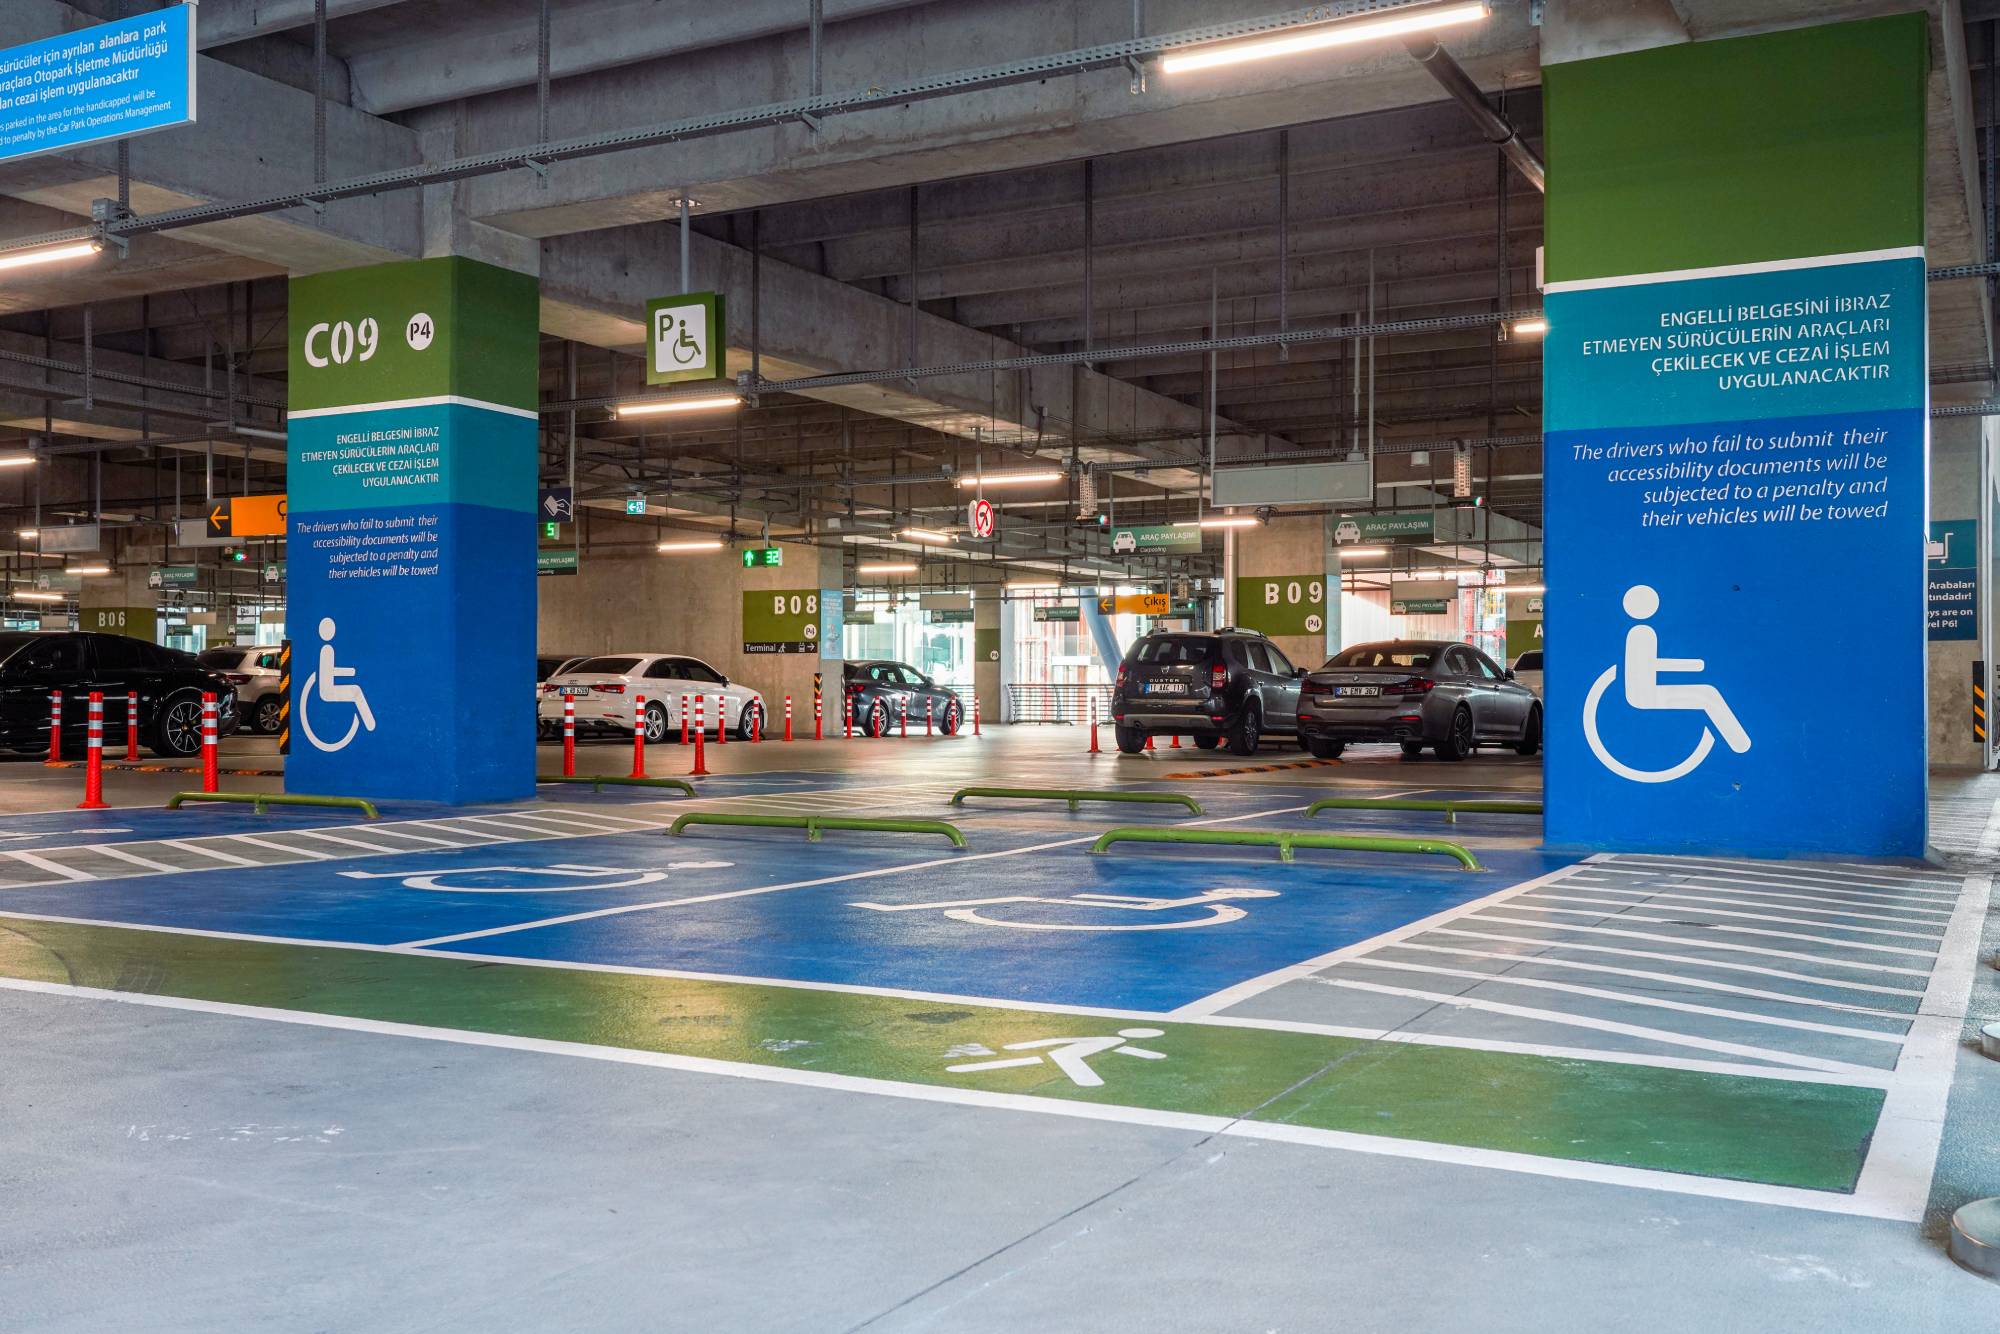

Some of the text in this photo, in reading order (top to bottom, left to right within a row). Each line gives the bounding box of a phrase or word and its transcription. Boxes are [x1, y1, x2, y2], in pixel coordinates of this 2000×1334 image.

[0, 21, 166, 74] sürücüler için ayrılan alanlara park
[34, 63, 72, 83] Otopark
[75, 57, 110, 76] İşletme
[112, 40, 167, 64] Müdürlüğü
[15, 90, 38, 106] cezai
[40, 86, 65, 103] işlem
[67, 68, 139, 96] uygulanacaktır
[6, 117, 27, 132] parked
[28, 116, 35, 125] in
[36, 114, 46, 123] the
[48, 112, 62, 121] area
[63, 107, 72, 118] for
[74, 105, 85, 115] the
[86, 93, 130, 112] handicapped
[133, 90, 144, 102] will
[146, 88, 156, 99] be
[4, 136, 11, 144] to
[12, 130, 36, 144] penalty
[38, 128, 45, 139] by
[47, 125, 57, 135] the
[59, 123, 69, 133] Car
[71, 119, 85, 130] Park
[86, 112, 124, 128] Operations
[125, 100, 171, 118] Management
[1661, 294, 1891, 328] ENGELLİ BELGESİNİ İBRAZ
[410, 321, 431, 341] P4
[660, 314, 674, 342] P
[1583, 318, 1890, 355] ETMEYEN SÜRÜCÜLERİN ARAÇLARI
[305, 318, 379, 368] C09
[1652, 341, 1890, 376] ÇEKİLECEK VE CEZAİ İŞLEM
[1720, 364, 1890, 390] UYGULANACAKTIR
[336, 426, 439, 445] ENGELLİ BELGESİNİ İBRAZ
[1573, 428, 1888, 460] The drivers who fail to submit their
[301, 443, 439, 462] ETMEYEN SÜRÜCÜLERİN ARAÇLARI
[332, 458, 439, 477] ÇEKİLECEK VE CEZAİ İŞLEM
[1608, 452, 1888, 482] accessibility documents will be
[363, 473, 439, 487] UYGULANACAKTIR
[1643, 476, 1888, 506] subjected to a penalty and
[1642, 500, 1888, 527] their vehicles will be towed
[297, 514, 439, 534] The drivers who fail to submit their
[547, 522, 554, 536] 5
[1366, 522, 1429, 532] ARAÇ PAYLAŞIMI
[313, 531, 438, 548] accessibility documents will be
[1140, 534, 1159, 542] ARAÇ
[330, 547, 439, 565] subjected to a penalty and
[766, 551, 779, 564] 32
[329, 564, 439, 579] their vehicles will be towed
[1265, 582, 1323, 605] B09
[1929, 581, 1975, 589] Arabaları
[774, 595, 817, 614] B08
[1144, 597, 1166, 608] Çıkış
[98, 612, 126, 627] B06
[1942, 620, 1958, 628] P6!
[746, 644, 776, 652] Terminal
